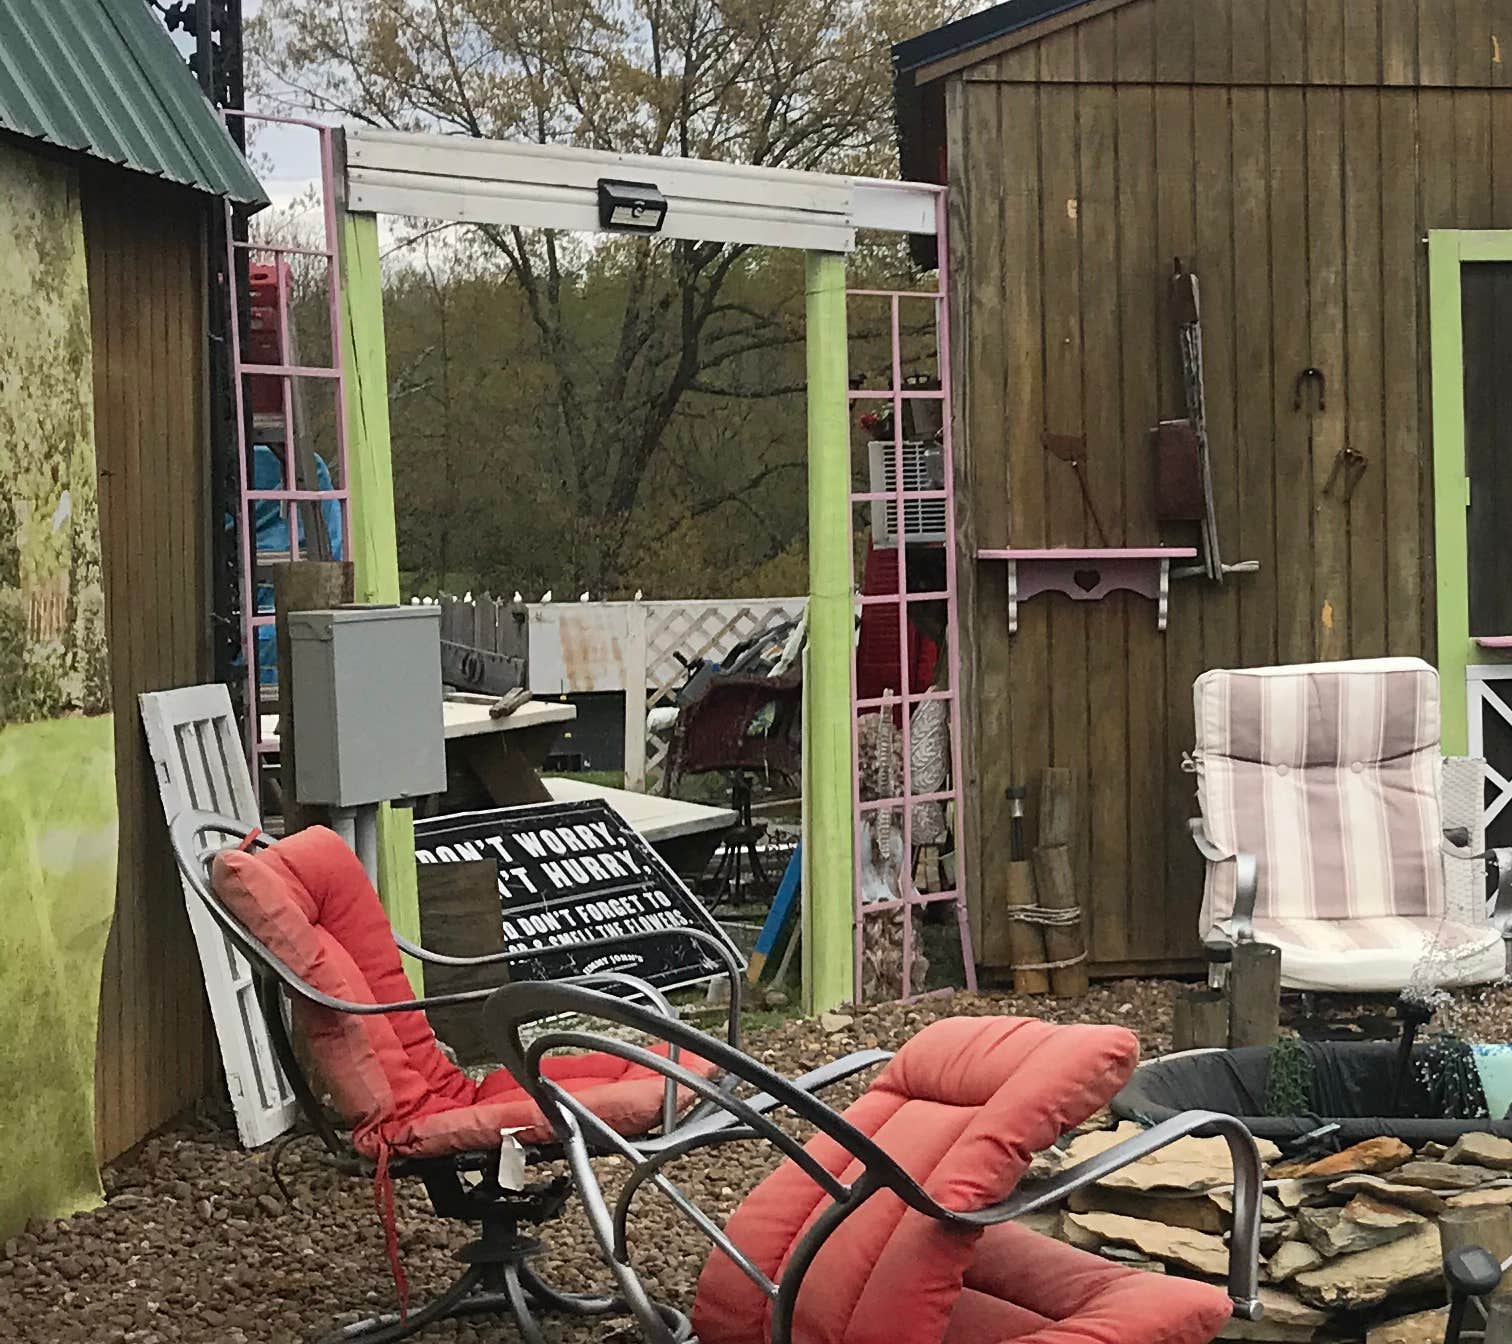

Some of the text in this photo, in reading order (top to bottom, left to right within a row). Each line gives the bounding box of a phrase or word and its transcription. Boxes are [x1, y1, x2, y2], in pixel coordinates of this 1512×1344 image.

[511, 821, 627, 858] WORRY,
[540, 849, 652, 889] HURRY,
[516, 908, 577, 937] DON'T
[574, 894, 646, 924] FORGET
[642, 889, 672, 910] TO
